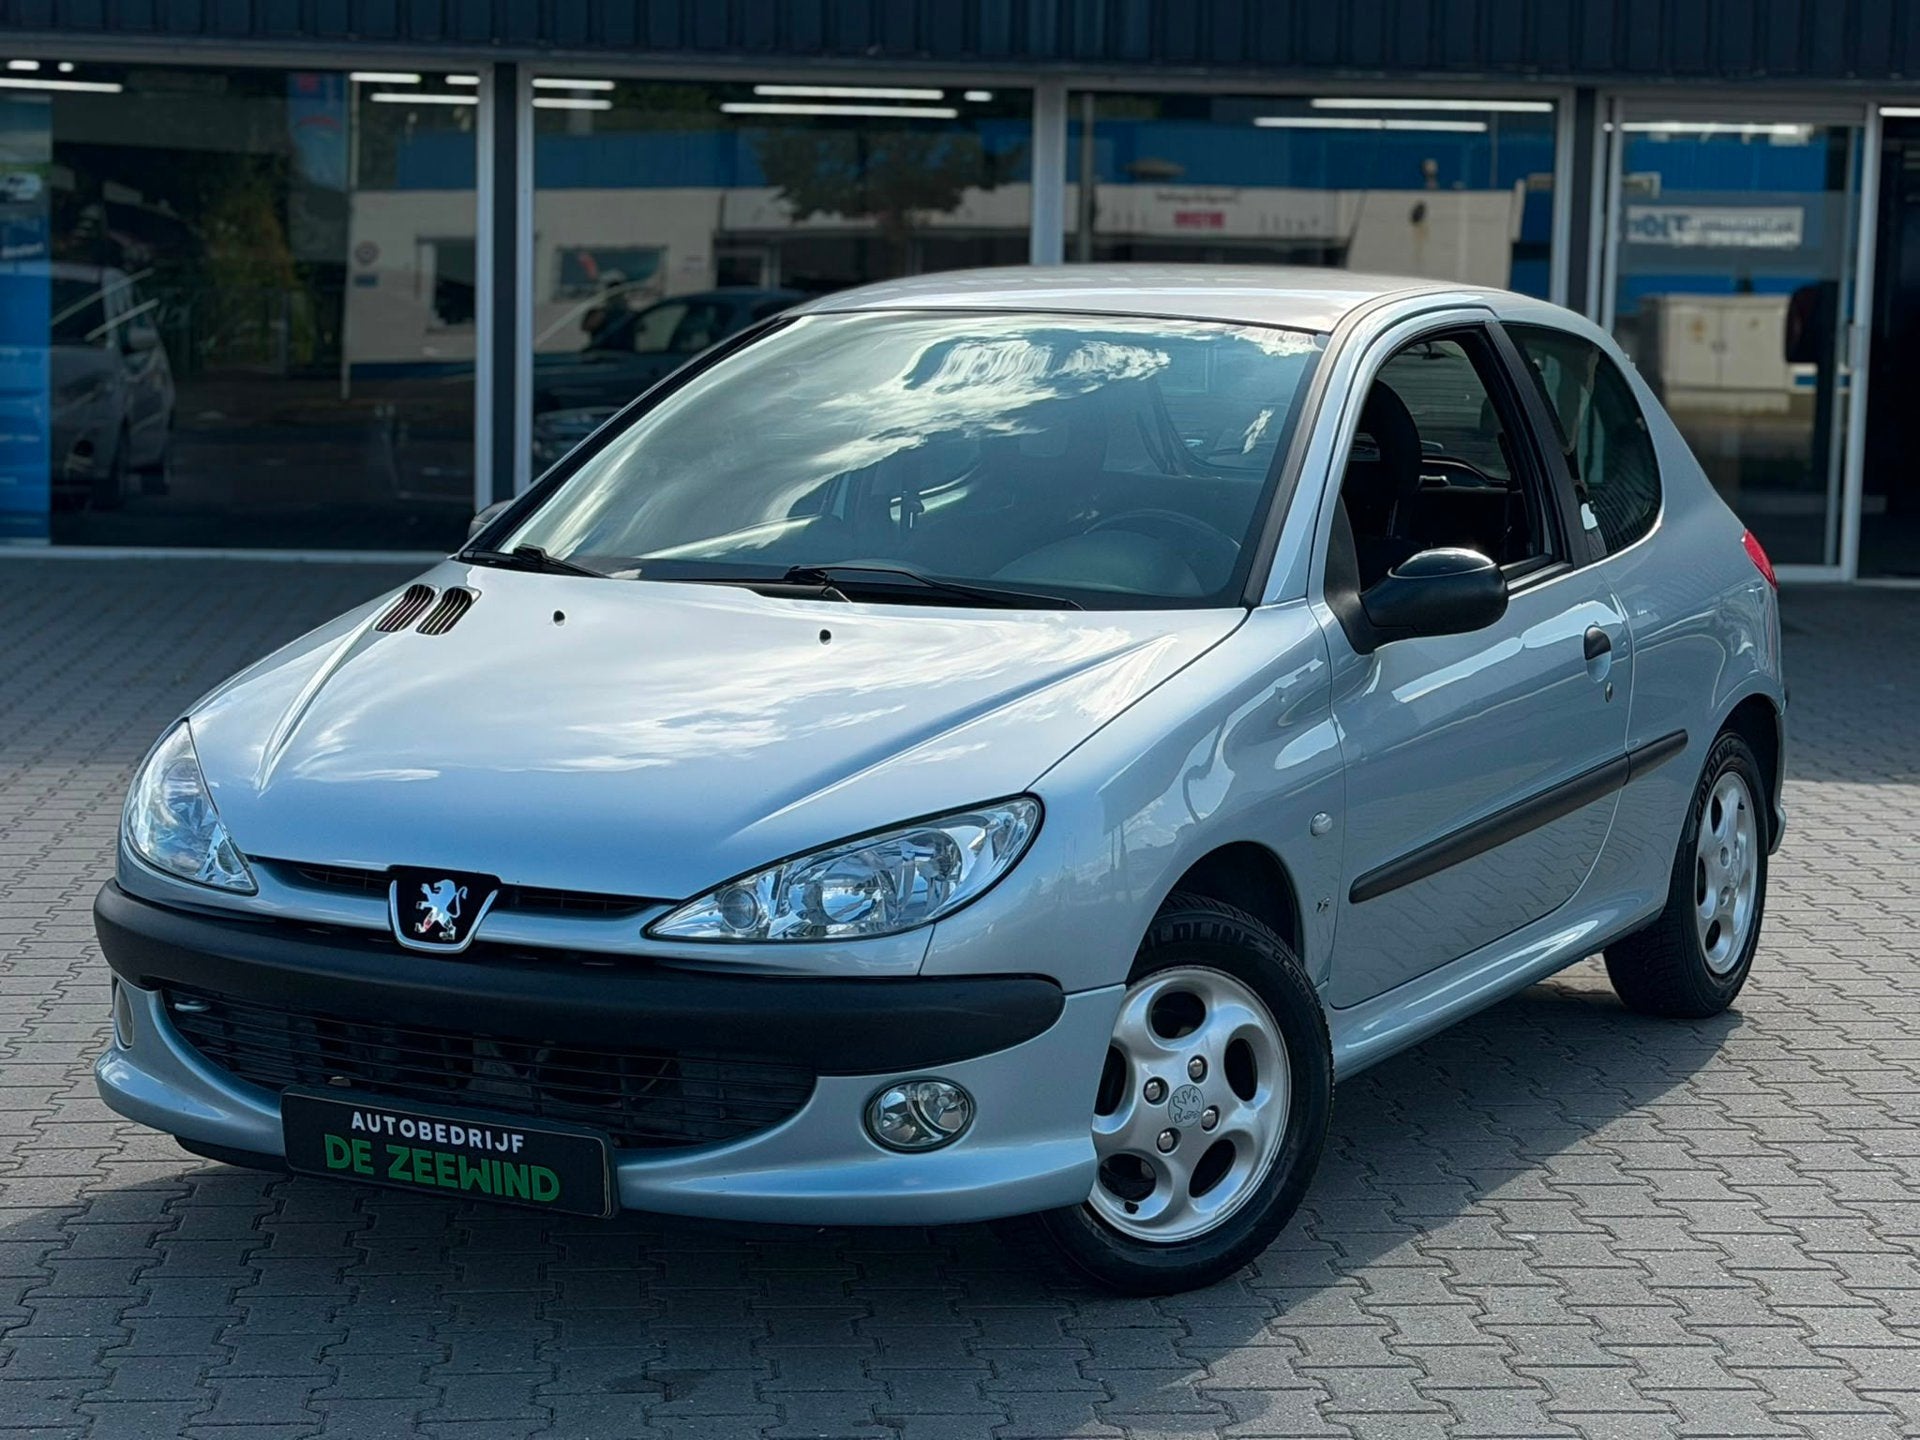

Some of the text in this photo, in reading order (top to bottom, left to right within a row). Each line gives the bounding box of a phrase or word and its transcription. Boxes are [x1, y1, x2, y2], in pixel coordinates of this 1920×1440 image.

[351, 1111, 524, 1153] AUTOBEDRIJF
[324, 1134, 560, 1202] DE ZEEWIND
